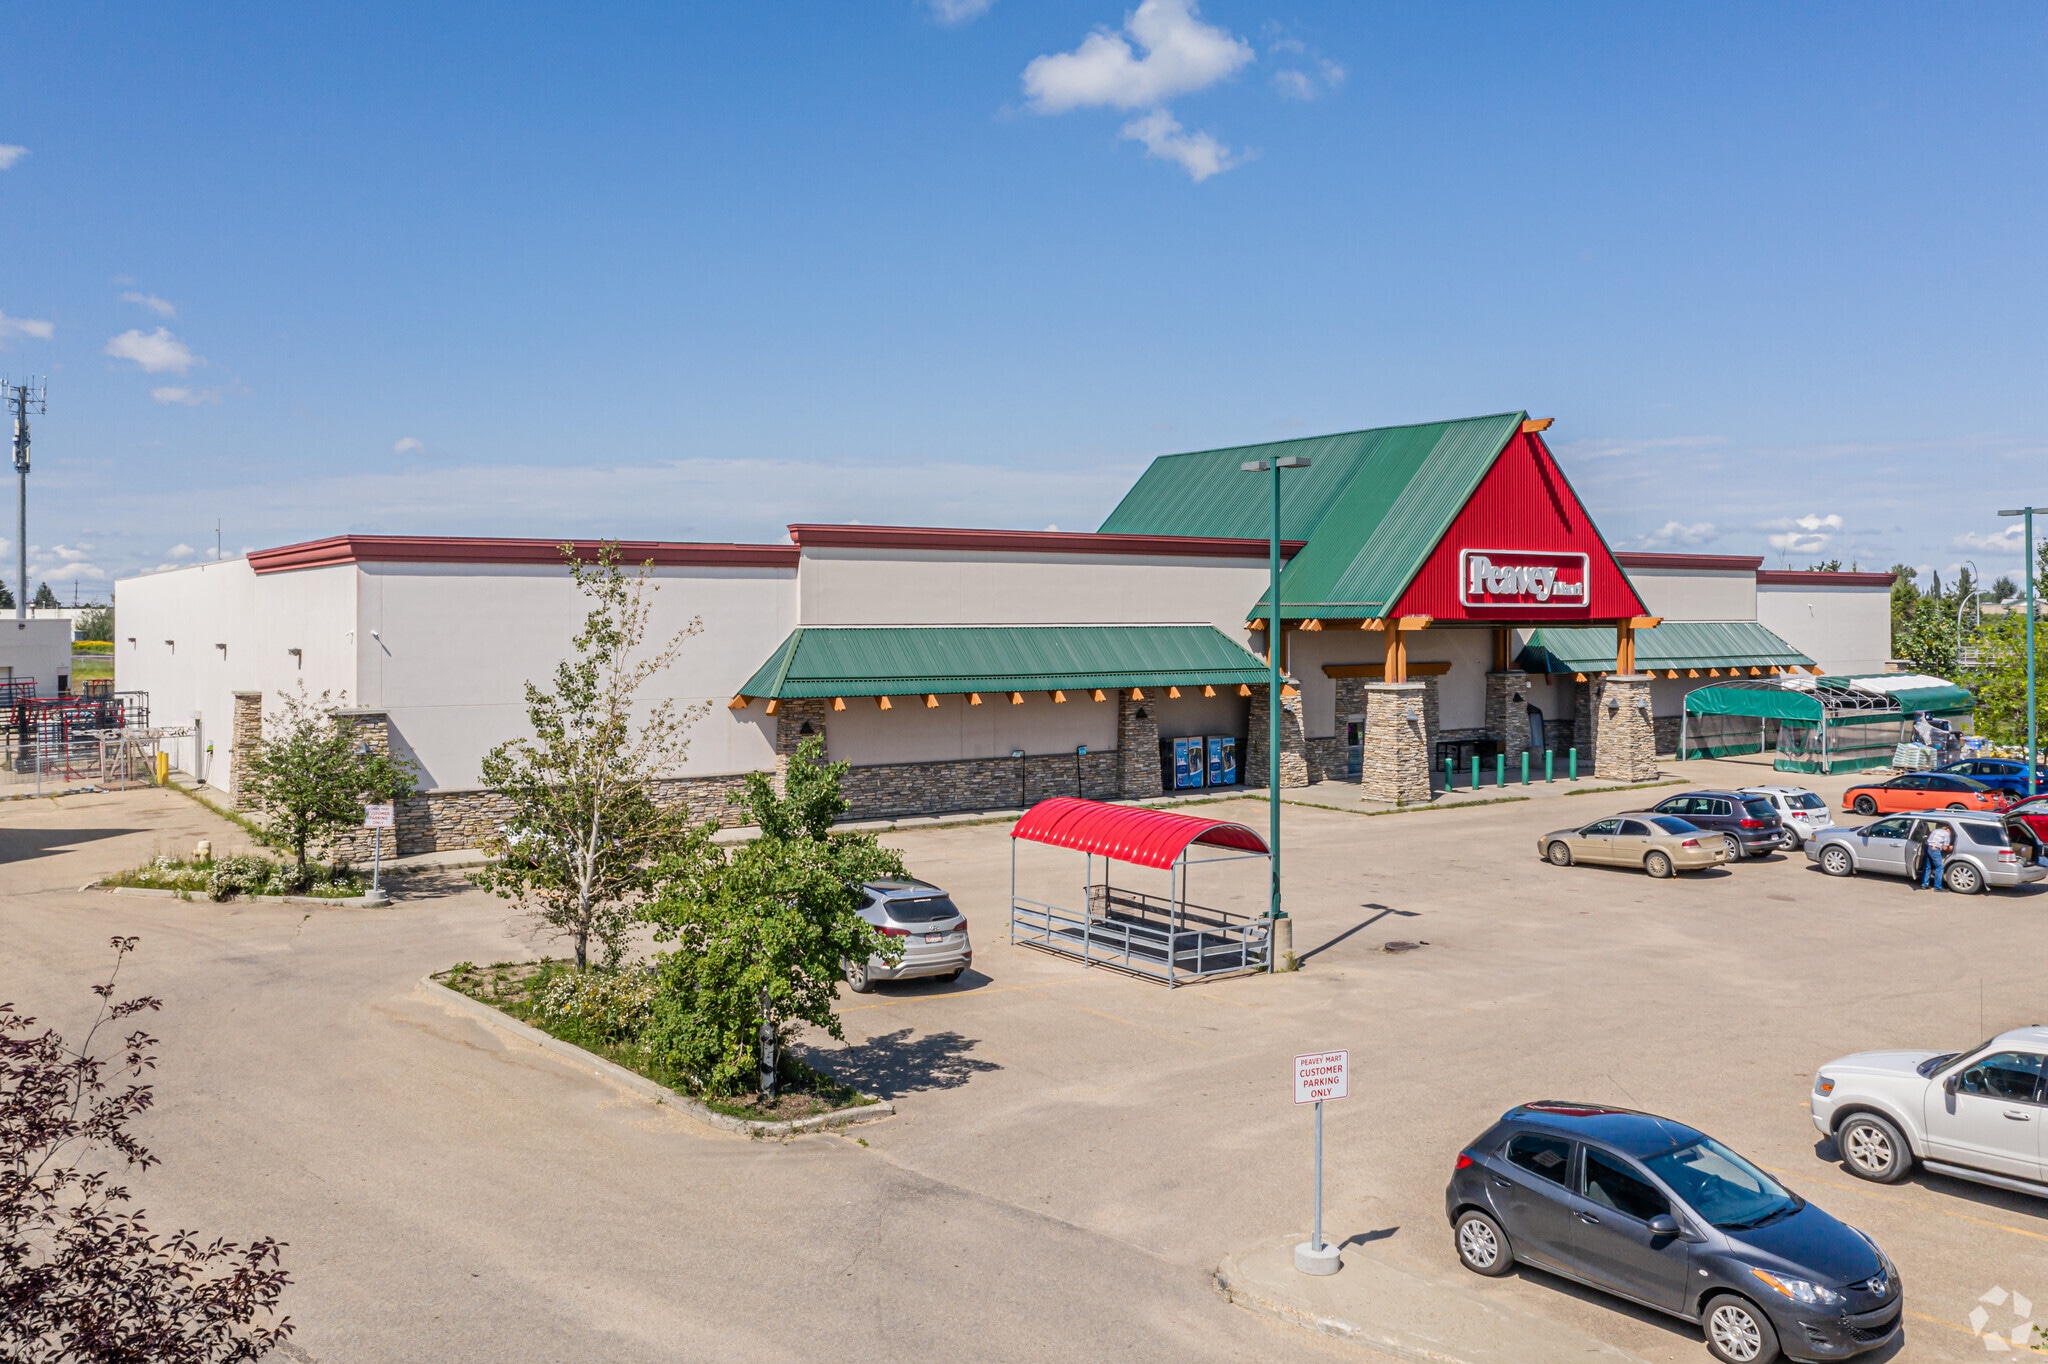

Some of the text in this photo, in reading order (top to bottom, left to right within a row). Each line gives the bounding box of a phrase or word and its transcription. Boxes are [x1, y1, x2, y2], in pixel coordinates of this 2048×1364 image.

[1468, 555, 1558, 602] Peavey
[1300, 1055, 1342, 1066] PEAVEY MART
[1299, 1065, 1343, 1077] CUSTOMER
[1303, 1076, 1340, 1088] PARKING
[1311, 1088, 1332, 1098] ONLY
